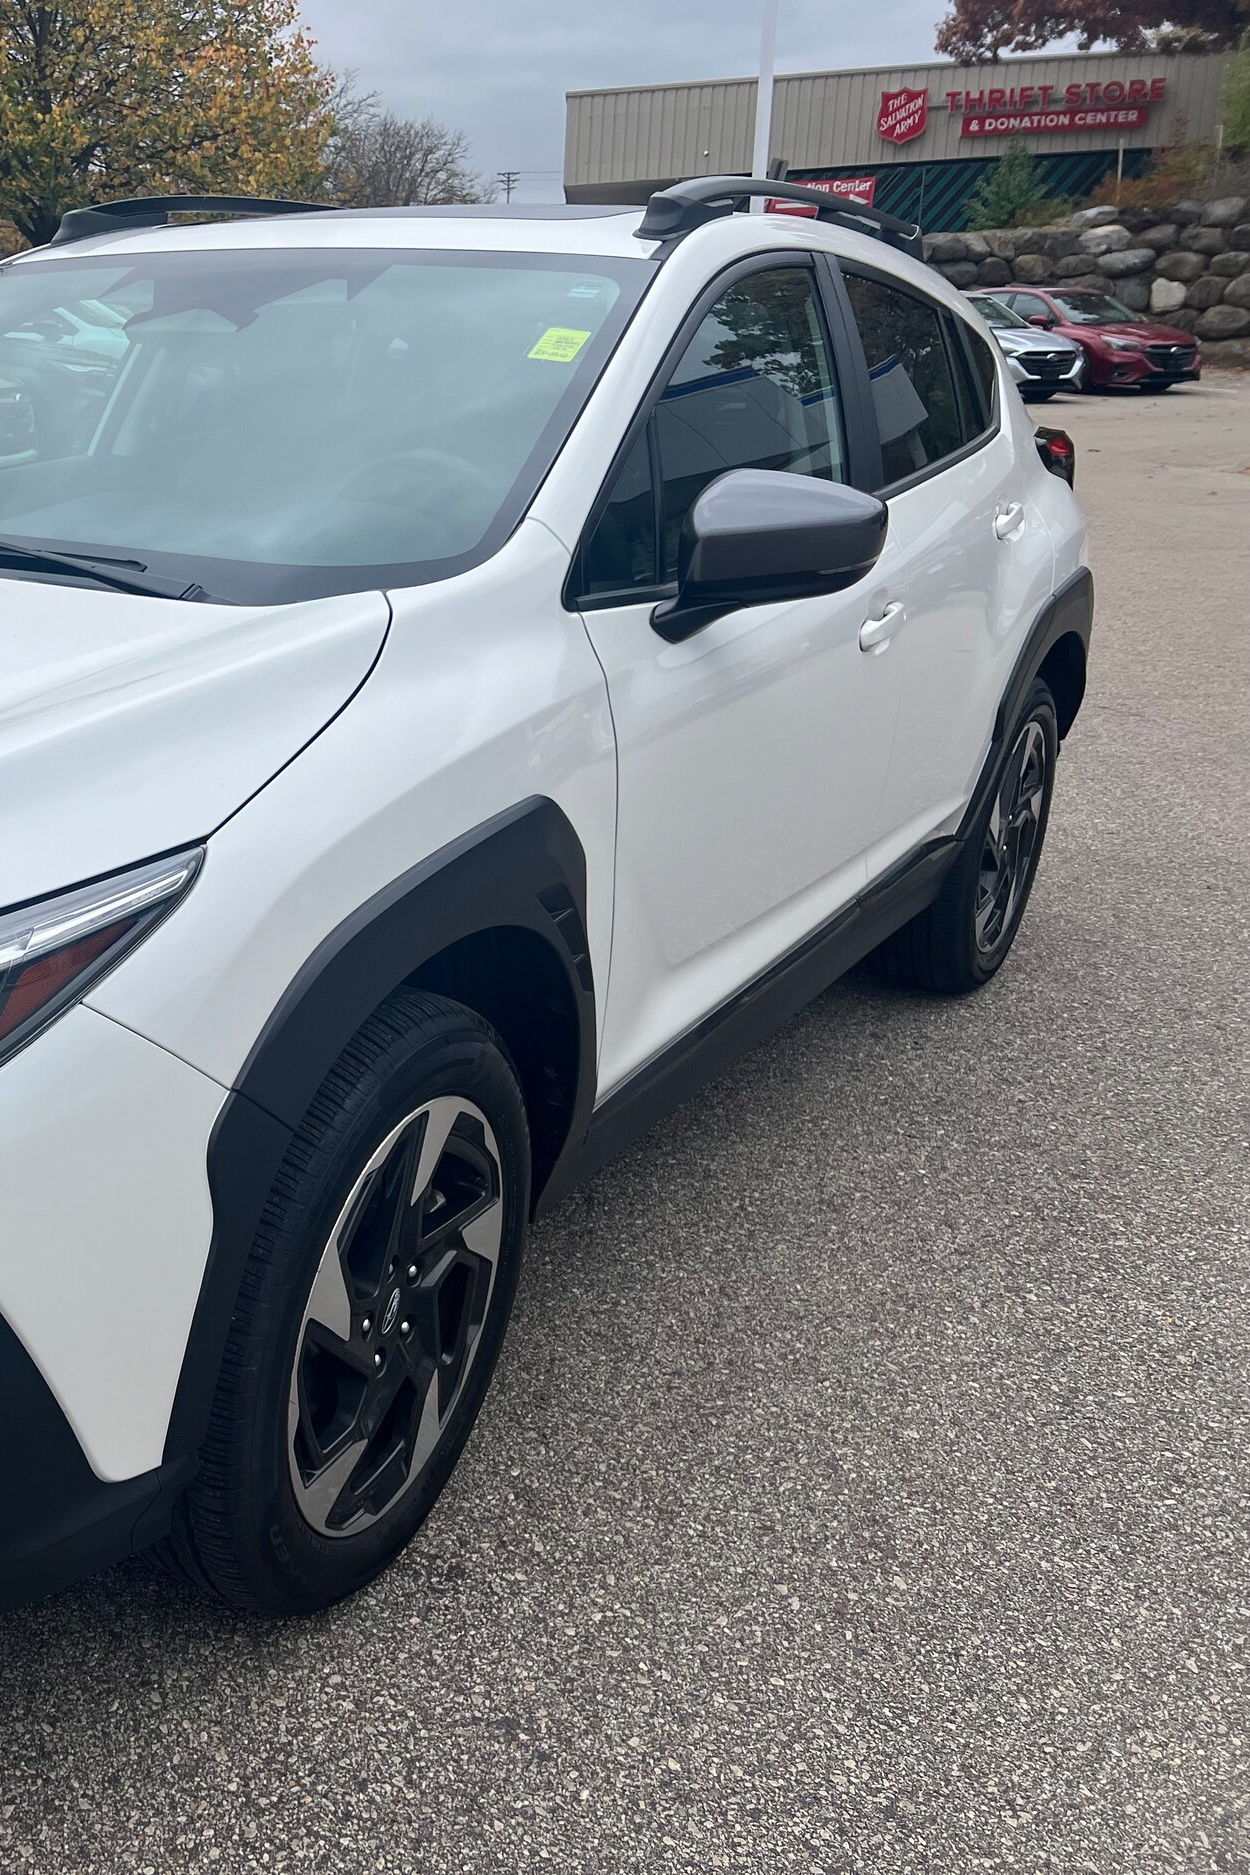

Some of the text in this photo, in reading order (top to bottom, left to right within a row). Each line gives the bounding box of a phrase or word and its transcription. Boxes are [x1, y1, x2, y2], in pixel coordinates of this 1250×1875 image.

[888, 92, 907, 111] THE
[945, 77, 1167, 113] THRIFT STORE
[879, 94, 924, 132] SALVATION
[893, 111, 922, 138] ARMY
[969, 110, 1138, 131] & DONATION CENTER
[833, 180, 872, 192] Center
